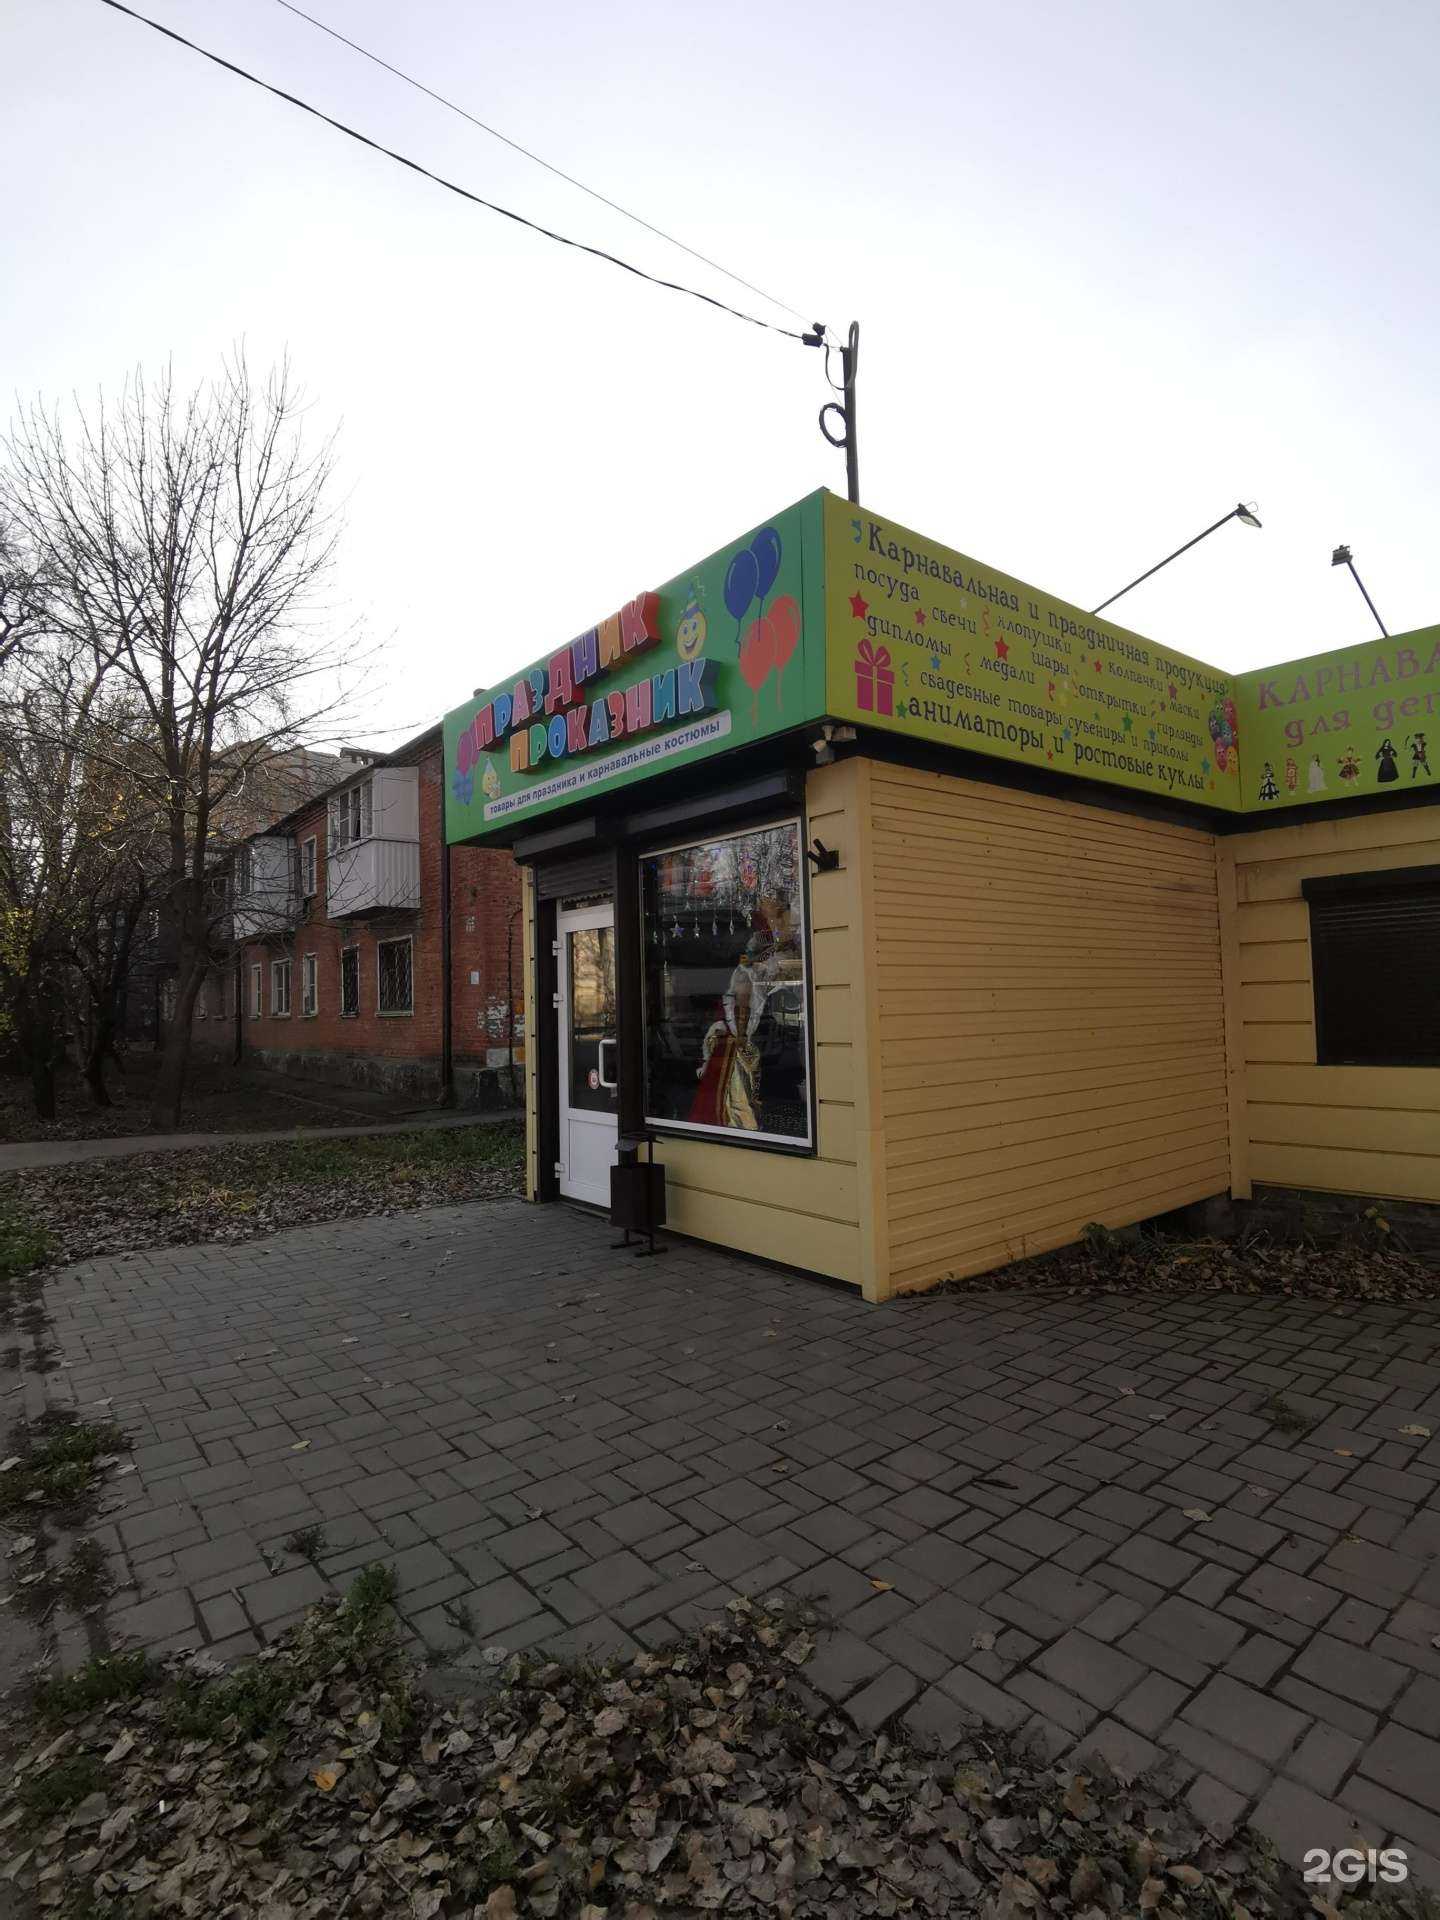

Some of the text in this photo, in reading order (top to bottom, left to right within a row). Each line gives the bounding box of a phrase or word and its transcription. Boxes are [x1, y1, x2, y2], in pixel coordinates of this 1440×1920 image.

[854, 563, 1200, 720] посуда свечи хлопушки колпачки маски
[868, 522, 1226, 696] Карнавальная и праздничная продукция
[473, 591, 657, 751] ПРАЗДНИК
[509, 657, 713, 773] ПРОКАЗНИК
[867, 615, 1204, 748] дипломы медали шары открытки гирлянды
[920, 671, 1189, 762] свадебные товары сувениры и приколы
[1284, 709, 1351, 748] для
[490, 721, 720, 814] товары для праздника и карнавальные костюмы
[908, 696, 1205, 791] аниматоры и ростовые куклы
